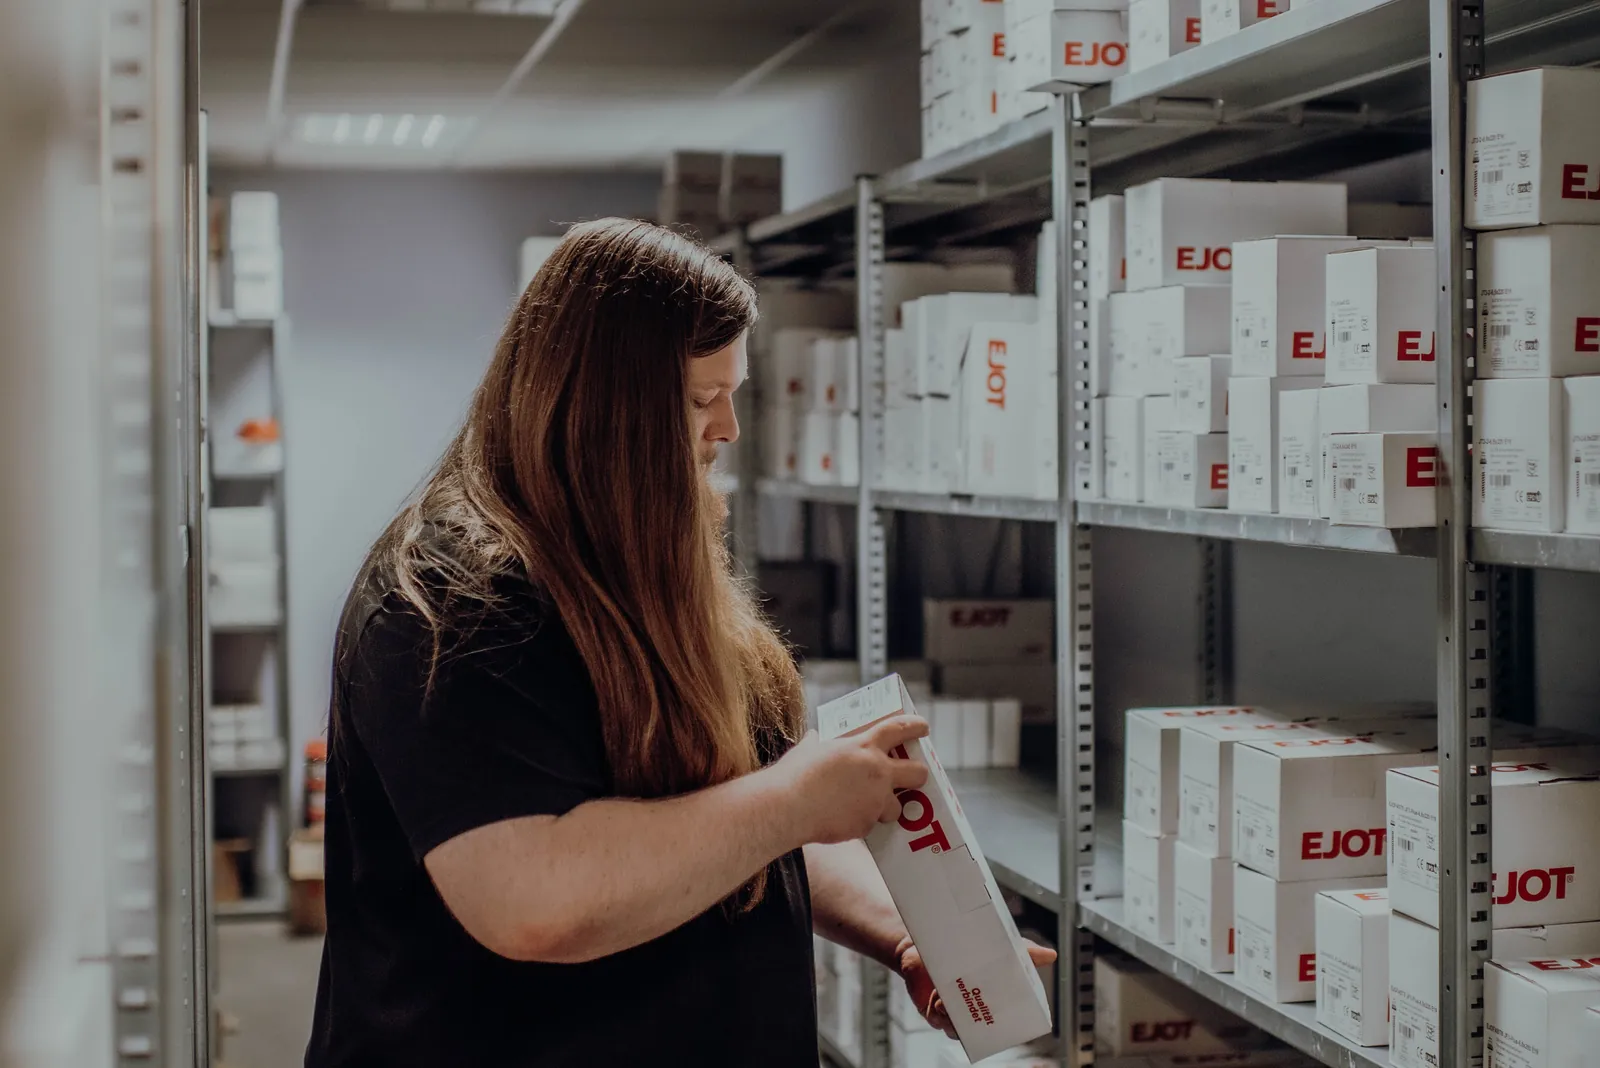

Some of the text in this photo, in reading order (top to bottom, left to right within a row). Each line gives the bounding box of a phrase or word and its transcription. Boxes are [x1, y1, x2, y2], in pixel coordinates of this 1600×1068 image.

[1064, 42, 1129, 67] EJO
[1176, 247, 1232, 271] EJO
[987, 339, 1007, 411] EJOT
[955, 977, 983, 1023] verbindet
[971, 987, 995, 1026] Qualität
